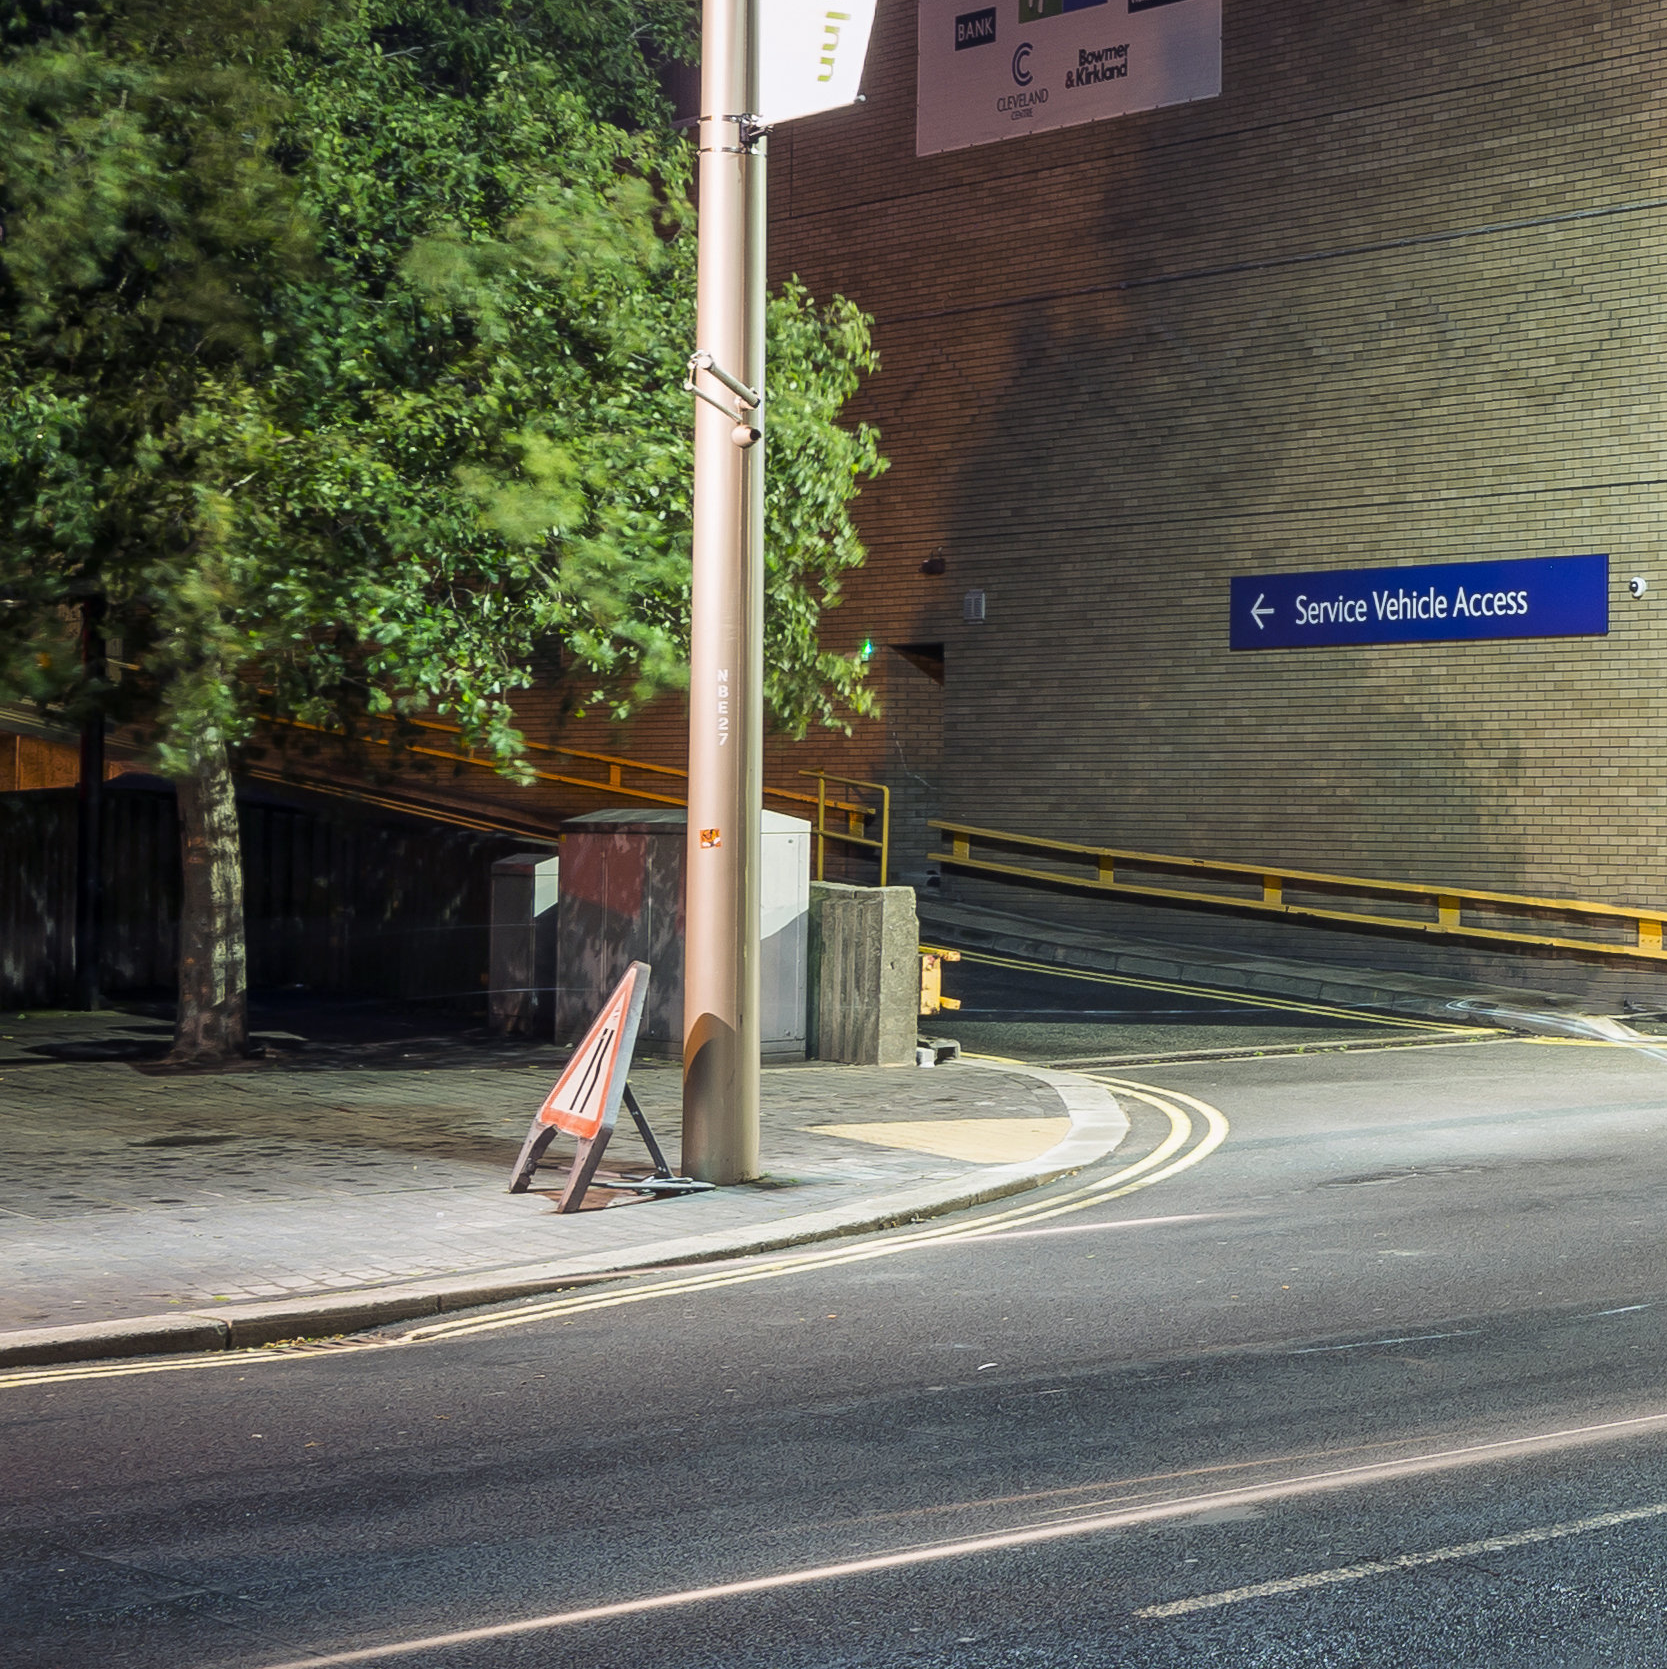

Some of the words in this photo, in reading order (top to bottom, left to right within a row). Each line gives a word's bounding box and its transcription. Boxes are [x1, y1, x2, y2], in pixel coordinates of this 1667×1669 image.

[957, 16, 993, 42] BANK
[817, 11, 852, 83] Inn
[1078, 43, 1130, 68] Bowmer
[997, 88, 1049, 112] CLEVELAND
[1295, 594, 1367, 625] Service
[1372, 586, 1448, 621] Vehicle
[1452, 586, 1528, 618] Access
[717, 668, 729, 746] NBE27
